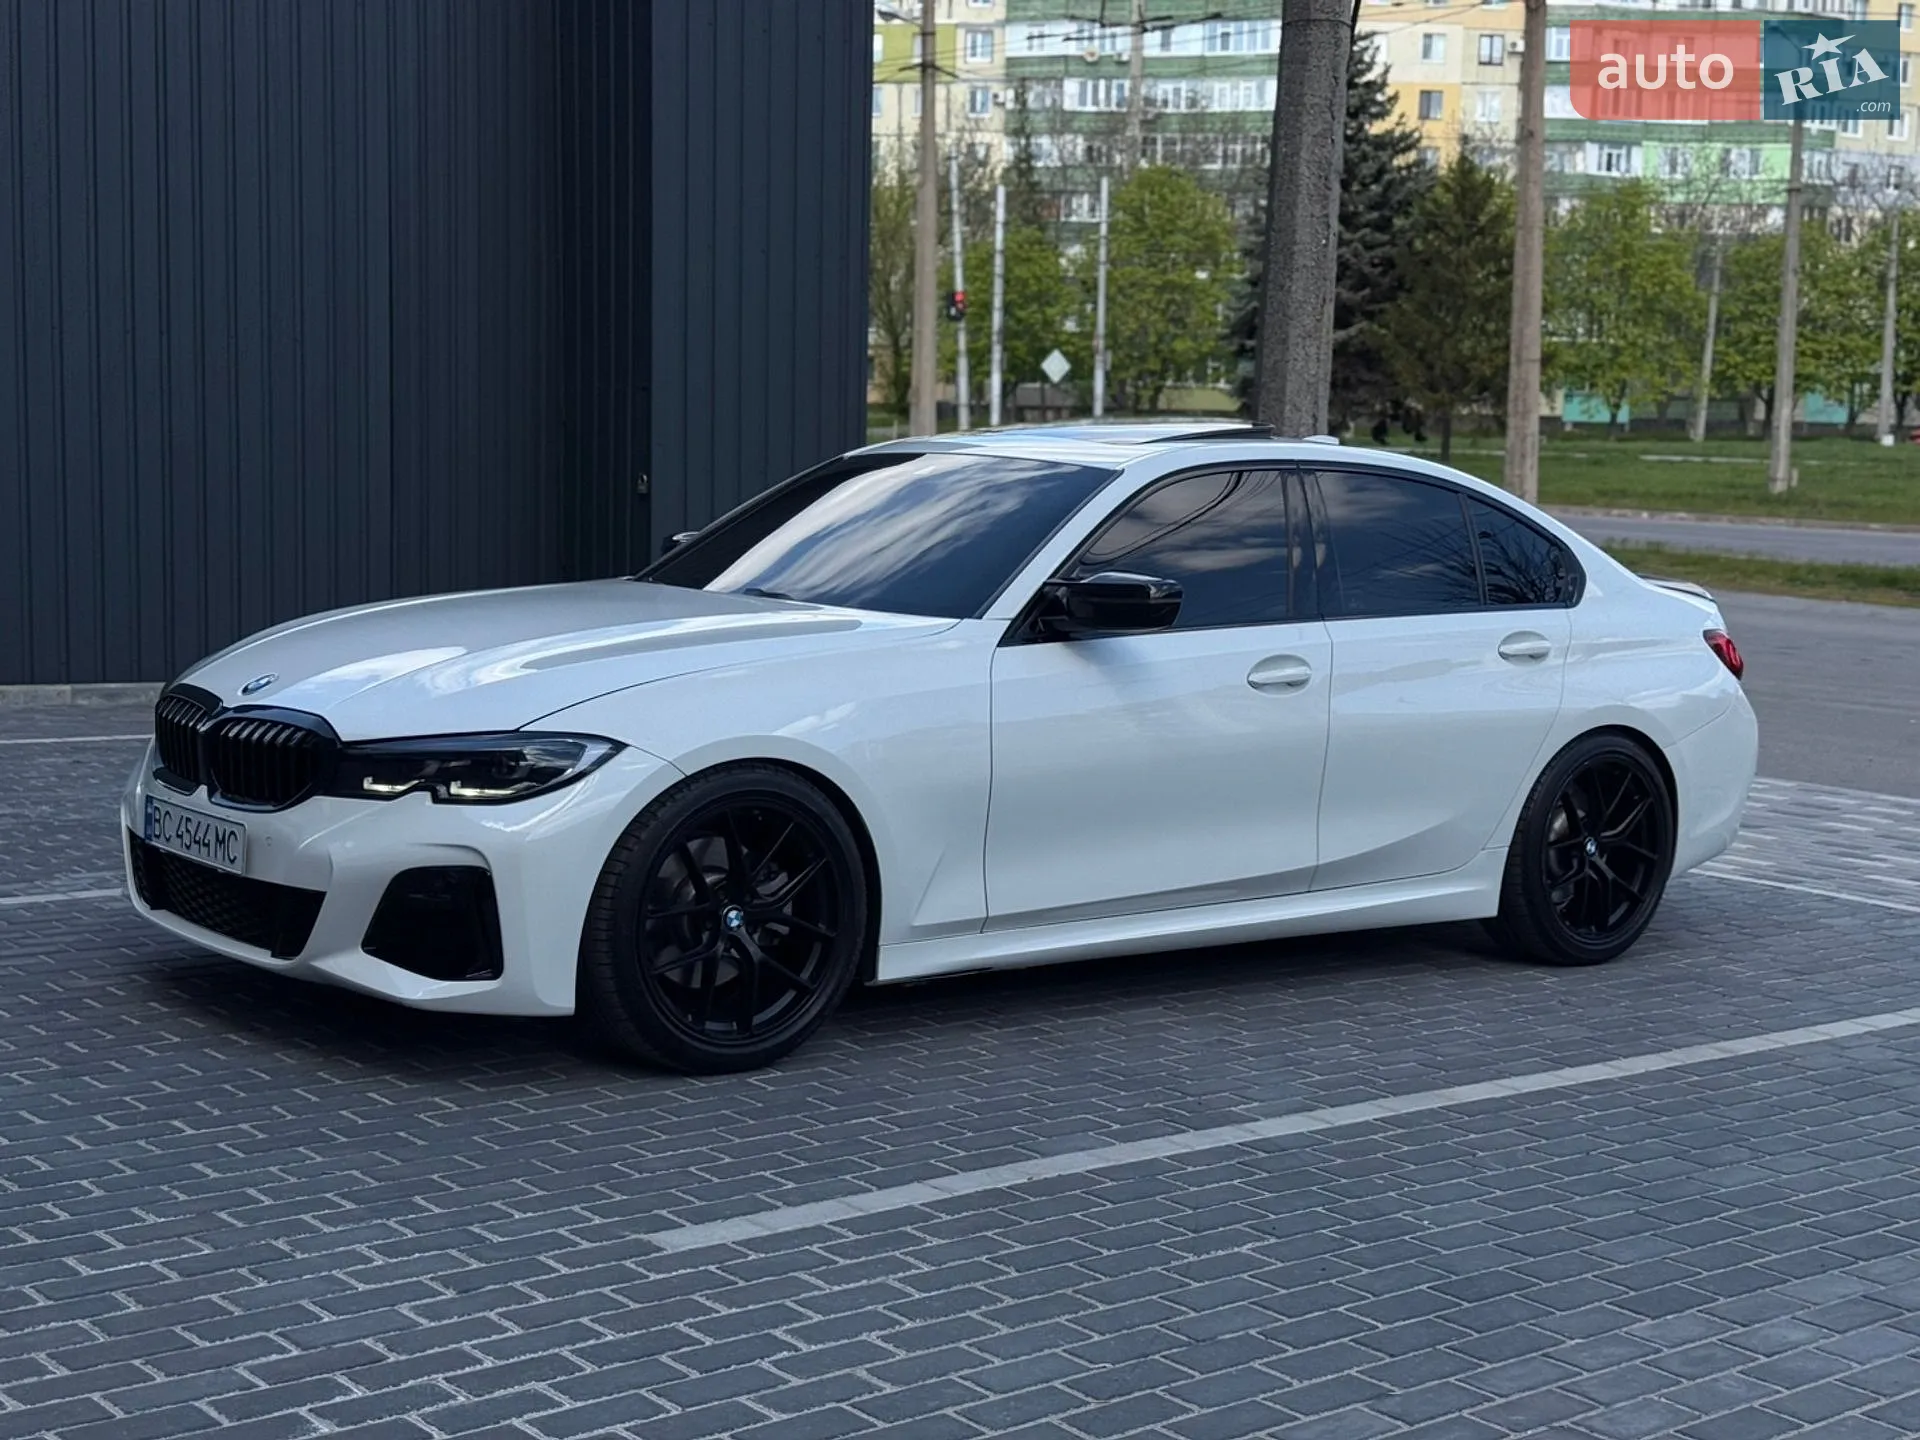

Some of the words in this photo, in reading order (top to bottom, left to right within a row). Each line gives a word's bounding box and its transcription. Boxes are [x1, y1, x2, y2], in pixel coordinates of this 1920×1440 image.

[153, 804, 173, 842] BC
[176, 814, 211, 858] 4544
[215, 825, 238, 865] MC
